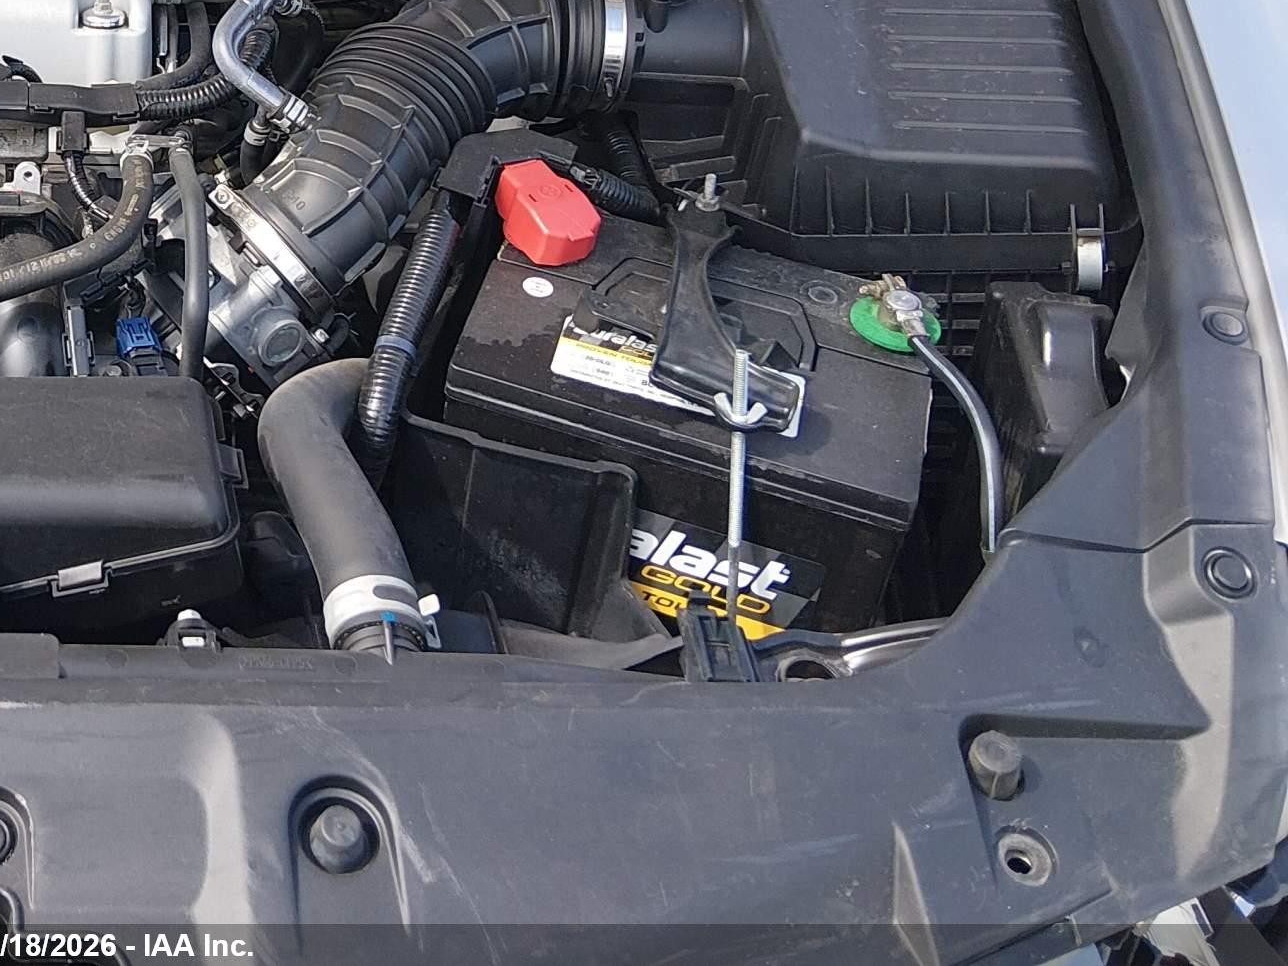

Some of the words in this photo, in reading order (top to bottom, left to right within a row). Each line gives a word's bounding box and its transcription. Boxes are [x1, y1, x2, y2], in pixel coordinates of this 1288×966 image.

[571, 325, 658, 353] uralas
[630, 529, 790, 600] alast
[641, 565, 771, 614] GOLD
